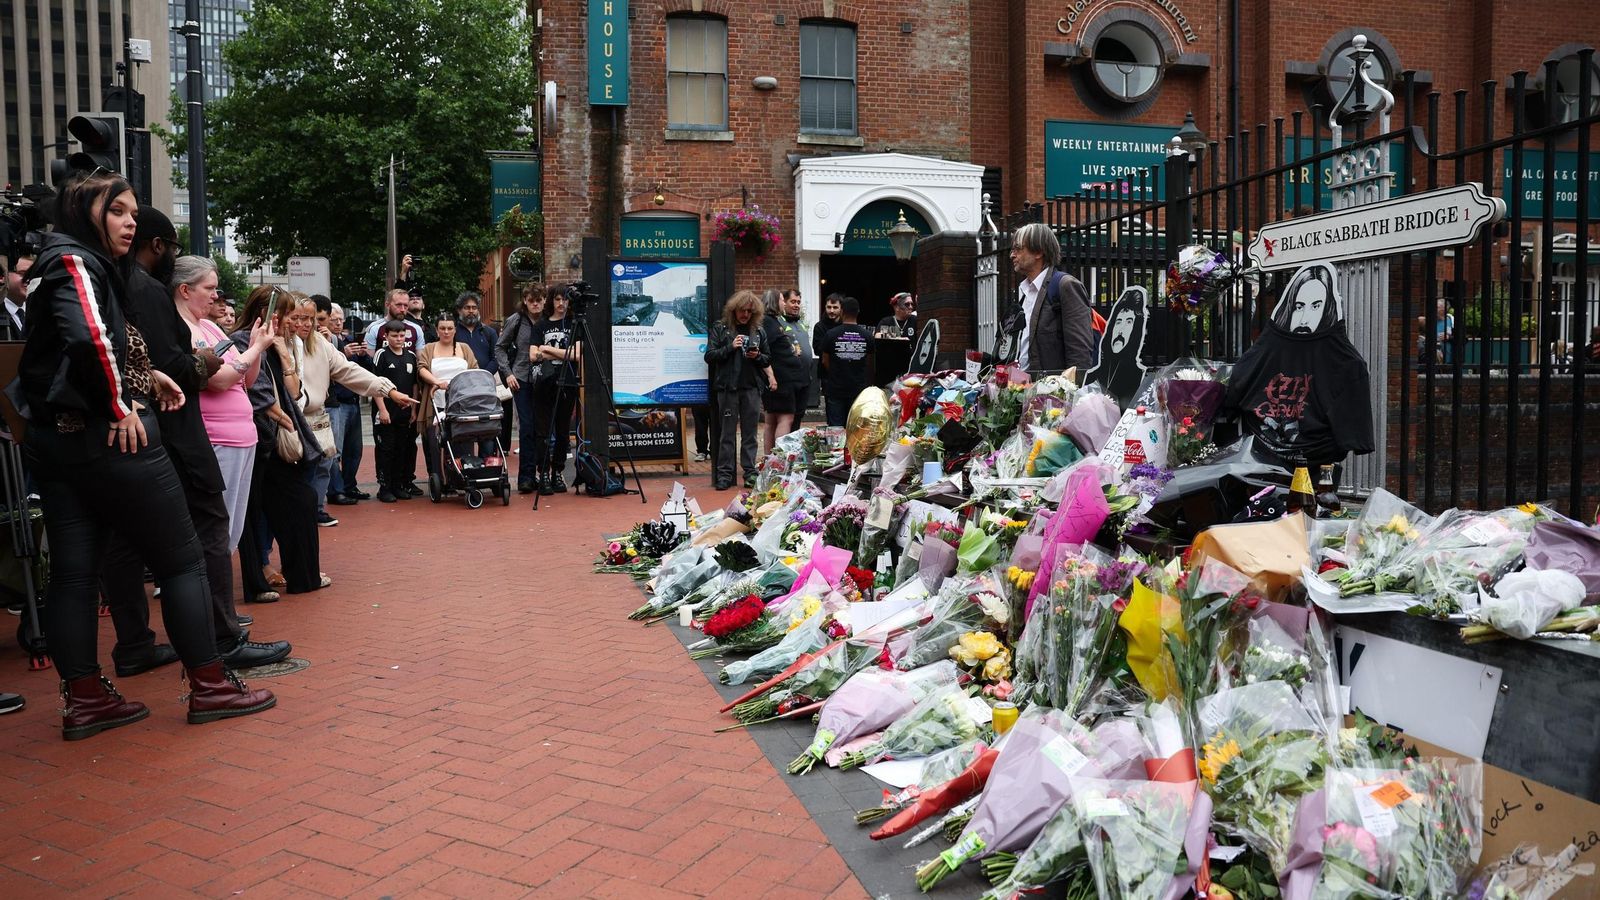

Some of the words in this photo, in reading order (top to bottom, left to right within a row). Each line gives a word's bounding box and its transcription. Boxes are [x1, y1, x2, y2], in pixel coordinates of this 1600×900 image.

[1053, 138, 1092, 150] WEEKLY
[1097, 141, 1172, 154] ENTERTAINME
[1082, 164, 1106, 176] LIVE
[1506, 168, 1533, 179] LAL
[1562, 171, 1568, 180] &
[1572, 171, 1599, 181] CFT
[1525, 190, 1543, 200] GRE
[881, 220, 893, 228] THE
[1281, 231, 1321, 251] BLACK
[1325, 218, 1389, 244] SABBATH
[1395, 206, 1458, 232] BRIDGE
[1464, 208, 1470, 221] 1
[625, 239, 694, 249] BRASSHOUSE
[627, 336, 640, 344] city
[633, 432, 652, 440] FROM
